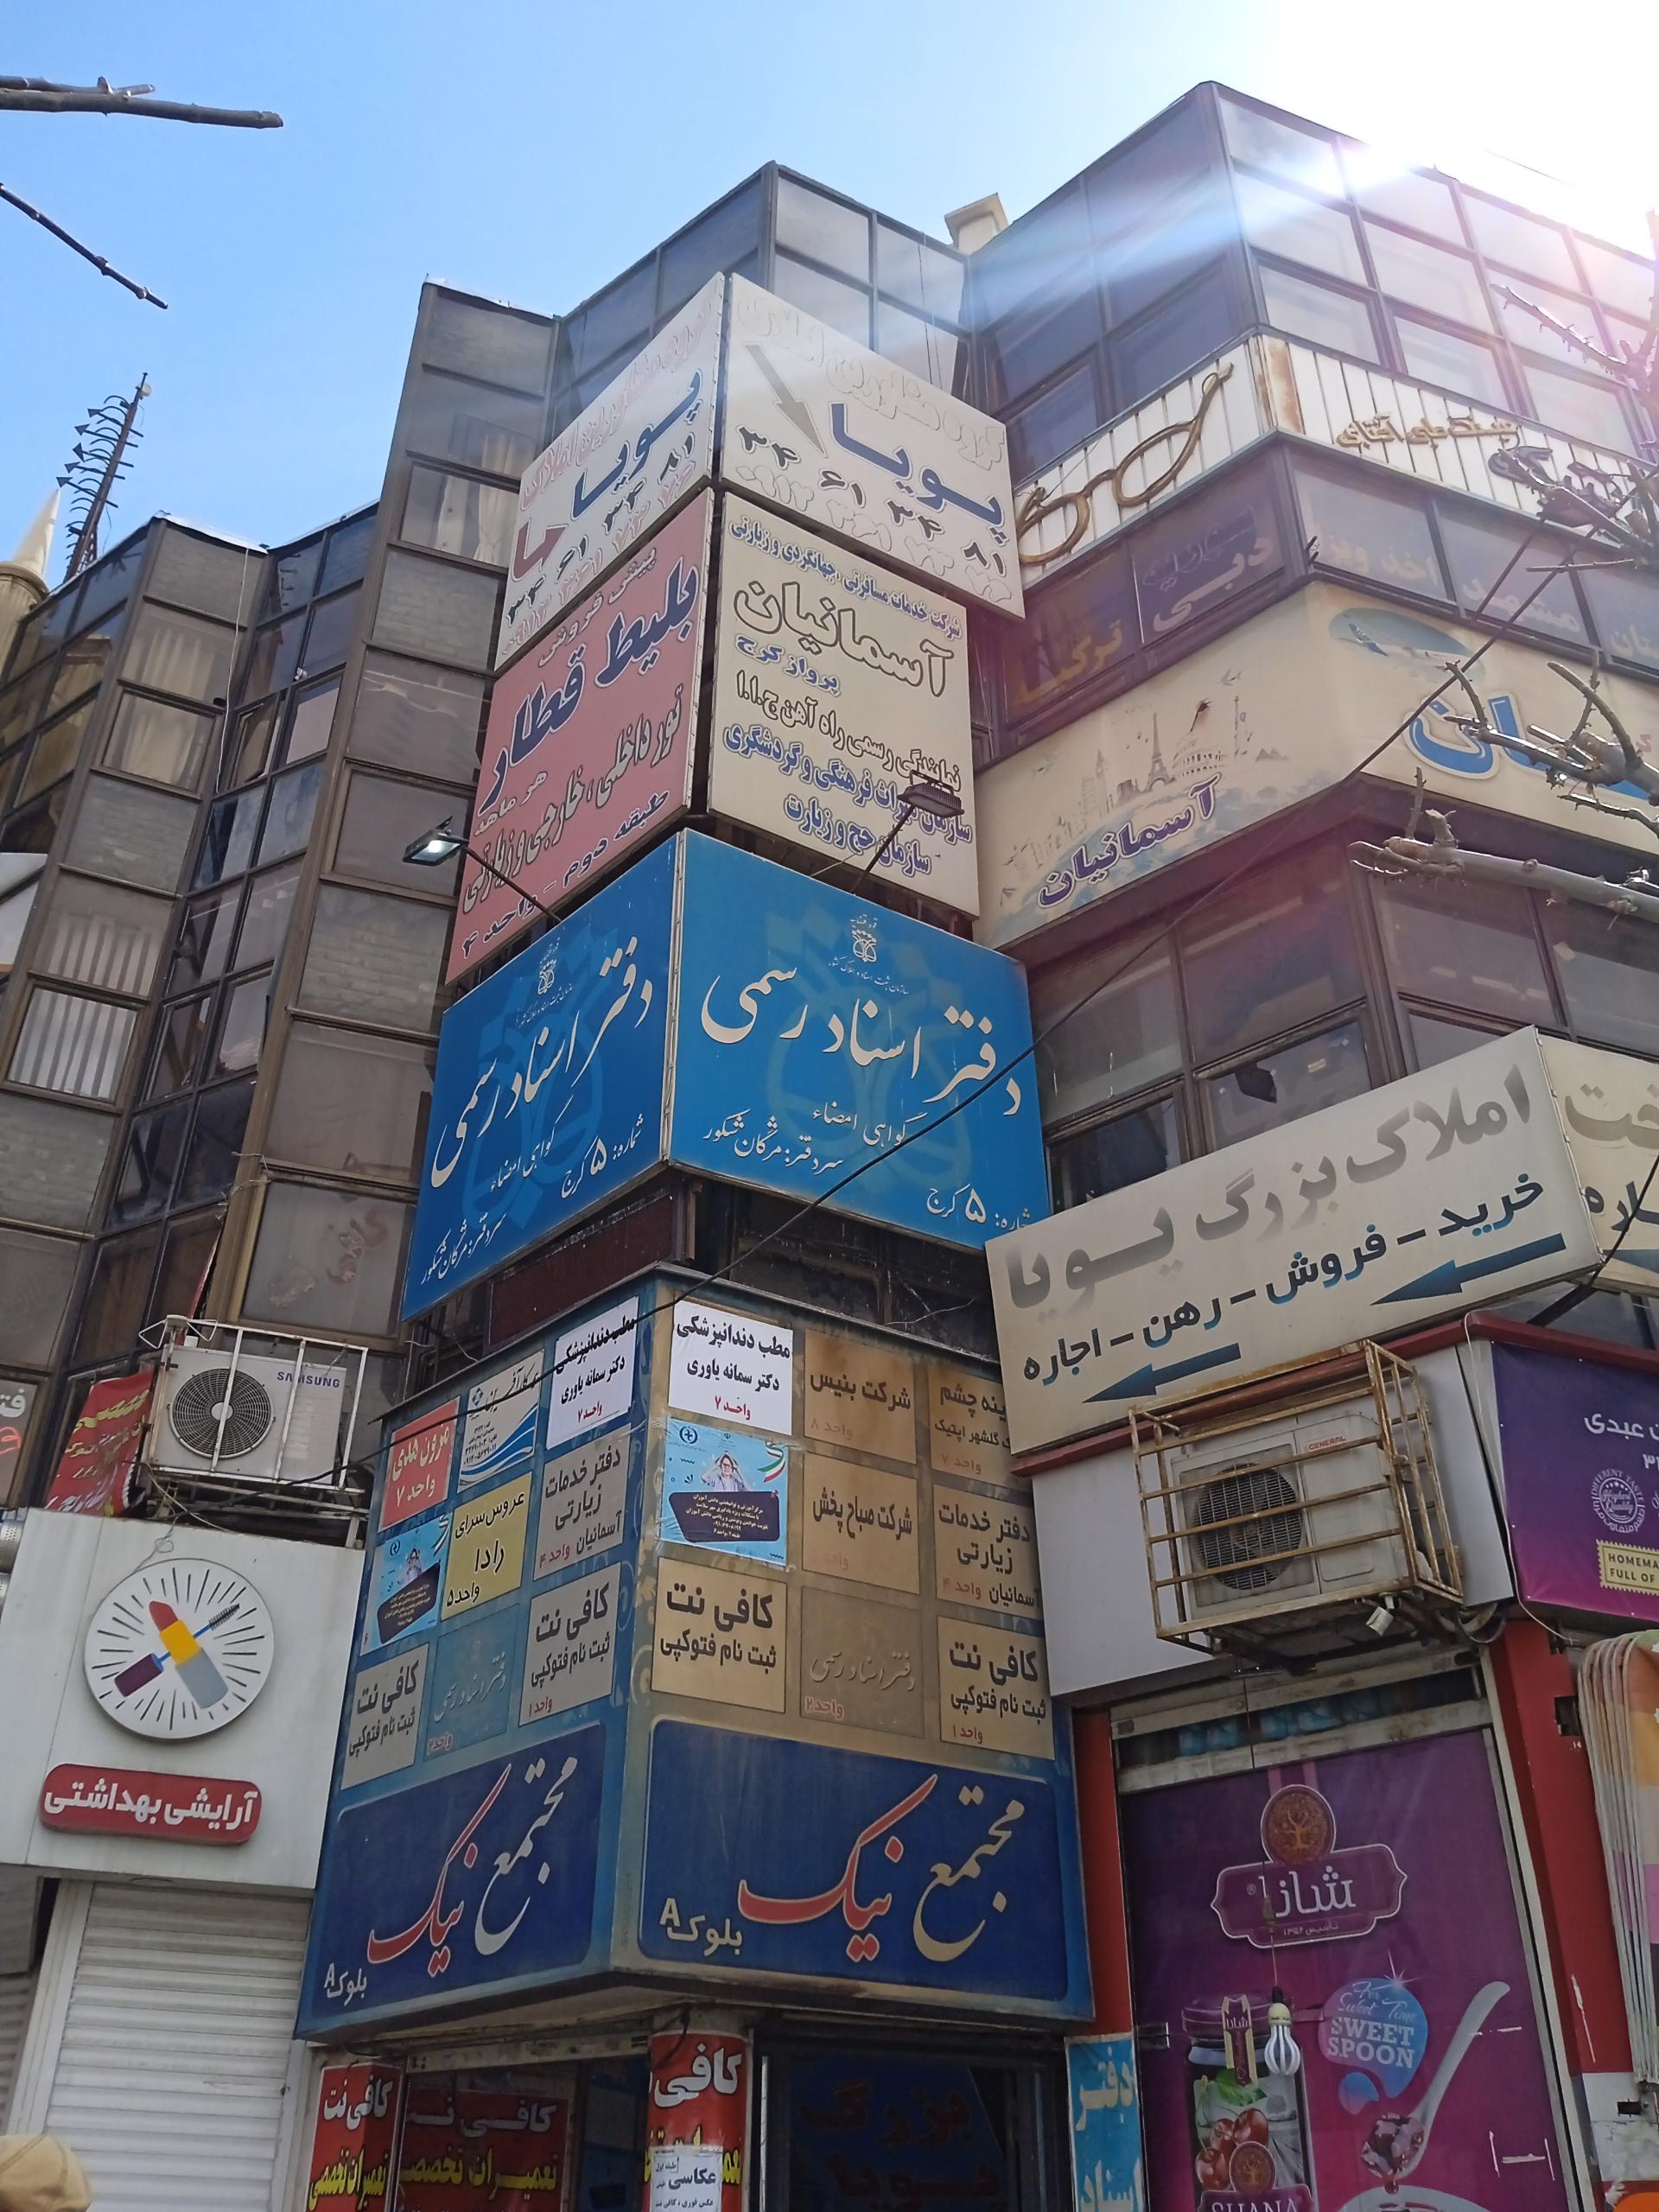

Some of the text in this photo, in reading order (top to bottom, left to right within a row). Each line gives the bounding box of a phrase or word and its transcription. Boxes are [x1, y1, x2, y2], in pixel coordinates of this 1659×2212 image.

[571, 369, 702, 520] پویا
[830, 402, 1008, 547] پویا
[729, 517, 963, 641] شرکت خدمات زیارتی
[1153, 537, 1274, 632] دبی
[734, 580, 954, 697] آسمانیان
[479, 556, 699, 817] بلیط قطار
[734, 632, 841, 698] پرواز کرج
[780, 696, 894, 771] رسمی آهن
[526, 685, 684, 866] تور خارجی
[723, 724, 874, 806] فرهنگی گردشگری
[563, 790, 670, 888] طبقه دوم
[785, 795, 875, 855] حج زیارت
[1036, 773, 1222, 909] آسمانیان
[430, 936, 653, 1188] دفتر اسناد رسمی
[701, 967, 1021, 1116] دفتر اسناد رسمی
[702, 1109, 783, 1160] مژگان شکور
[812, 1101, 927, 1148] گواهی امضاء
[1348, 1064, 1530, 1184] املاک
[560, 1134, 607, 1200] ۵ کرج
[926, 1183, 987, 1224] ۵ کرج
[1195, 1155, 1338, 1242] بزرگ
[1022, 1173, 1545, 1386] خرید فروش رهن اجاره
[677, 1315, 791, 1359] مطب دندانپزشکی
[561, 1376, 583, 1404] یاوری
[585, 1368, 606, 1386] سمانه
[607, 1355, 625, 1382] دکتر
[686, 1357, 779, 1392] دکتر سمانه یاوری
[583, 1401, 602, 1420] واحد
[723, 1402, 751, 1421] واحد
[862, 1382, 911, 1411] شرکت
[940, 1383, 976, 1417] چشم
[420, 1424, 448, 1466] مزون
[824, 1423, 852, 1440] واحد
[969, 1431, 1000, 1447] گلشهر
[1584, 1413, 1644, 1440] عبدی
[408, 1473, 435, 1501] واحد
[545, 1446, 621, 1498] دفتر خدمات
[955, 1459, 982, 1475] واحد
[455, 1493, 524, 1539] عروس سرای
[555, 1485, 601, 1530] زیارتی
[813, 1487, 842, 1534] پخش
[878, 1503, 912, 1541] شرکت
[938, 1503, 1031, 1542] دفتر خدمات
[475, 1540, 504, 1573] رادا
[550, 1510, 621, 1562] آسمانیان واحد
[957, 1542, 1014, 1574] زیارتی
[1608, 1553, 1659, 1569] HOMEMA
[1611, 1568, 1655, 1583] FULL OF
[536, 1582, 609, 1643] کافی نت
[666, 1583, 773, 1632] کافی نت
[955, 1581, 982, 1600] واحد
[531, 1631, 610, 1689] ثبت نام فتوکپی
[660, 1629, 777, 1675] ثبت نام فتوکپی
[950, 1642, 1038, 1686] کافی نت
[357, 1660, 419, 1714] کافی نت
[534, 1698, 552, 1714] واحد
[950, 1686, 1046, 1725] ثبت نام فتوکپی
[349, 1707, 416, 1758] ثبت نام فتوکپی
[960, 1727, 982, 1745] واحد
[43, 1778, 258, 1831] آرایشی بهداشتی
[367, 1757, 578, 1978] مجتمع نیک
[737, 1773, 1025, 1963] مجتمع نیک
[666, 1915, 743, 1956] بلوک
[1327, 2037, 1415, 2069] SPOON
[1330, 2017, 1414, 2046] SWEET
[653, 2043, 741, 2107] کافی
[1075, 2045, 1134, 2132] دفتر
[323, 2075, 394, 2130] کافی نت
[461, 2100, 557, 2138] کافی
[668, 2167, 716, 2190] عکاسی
